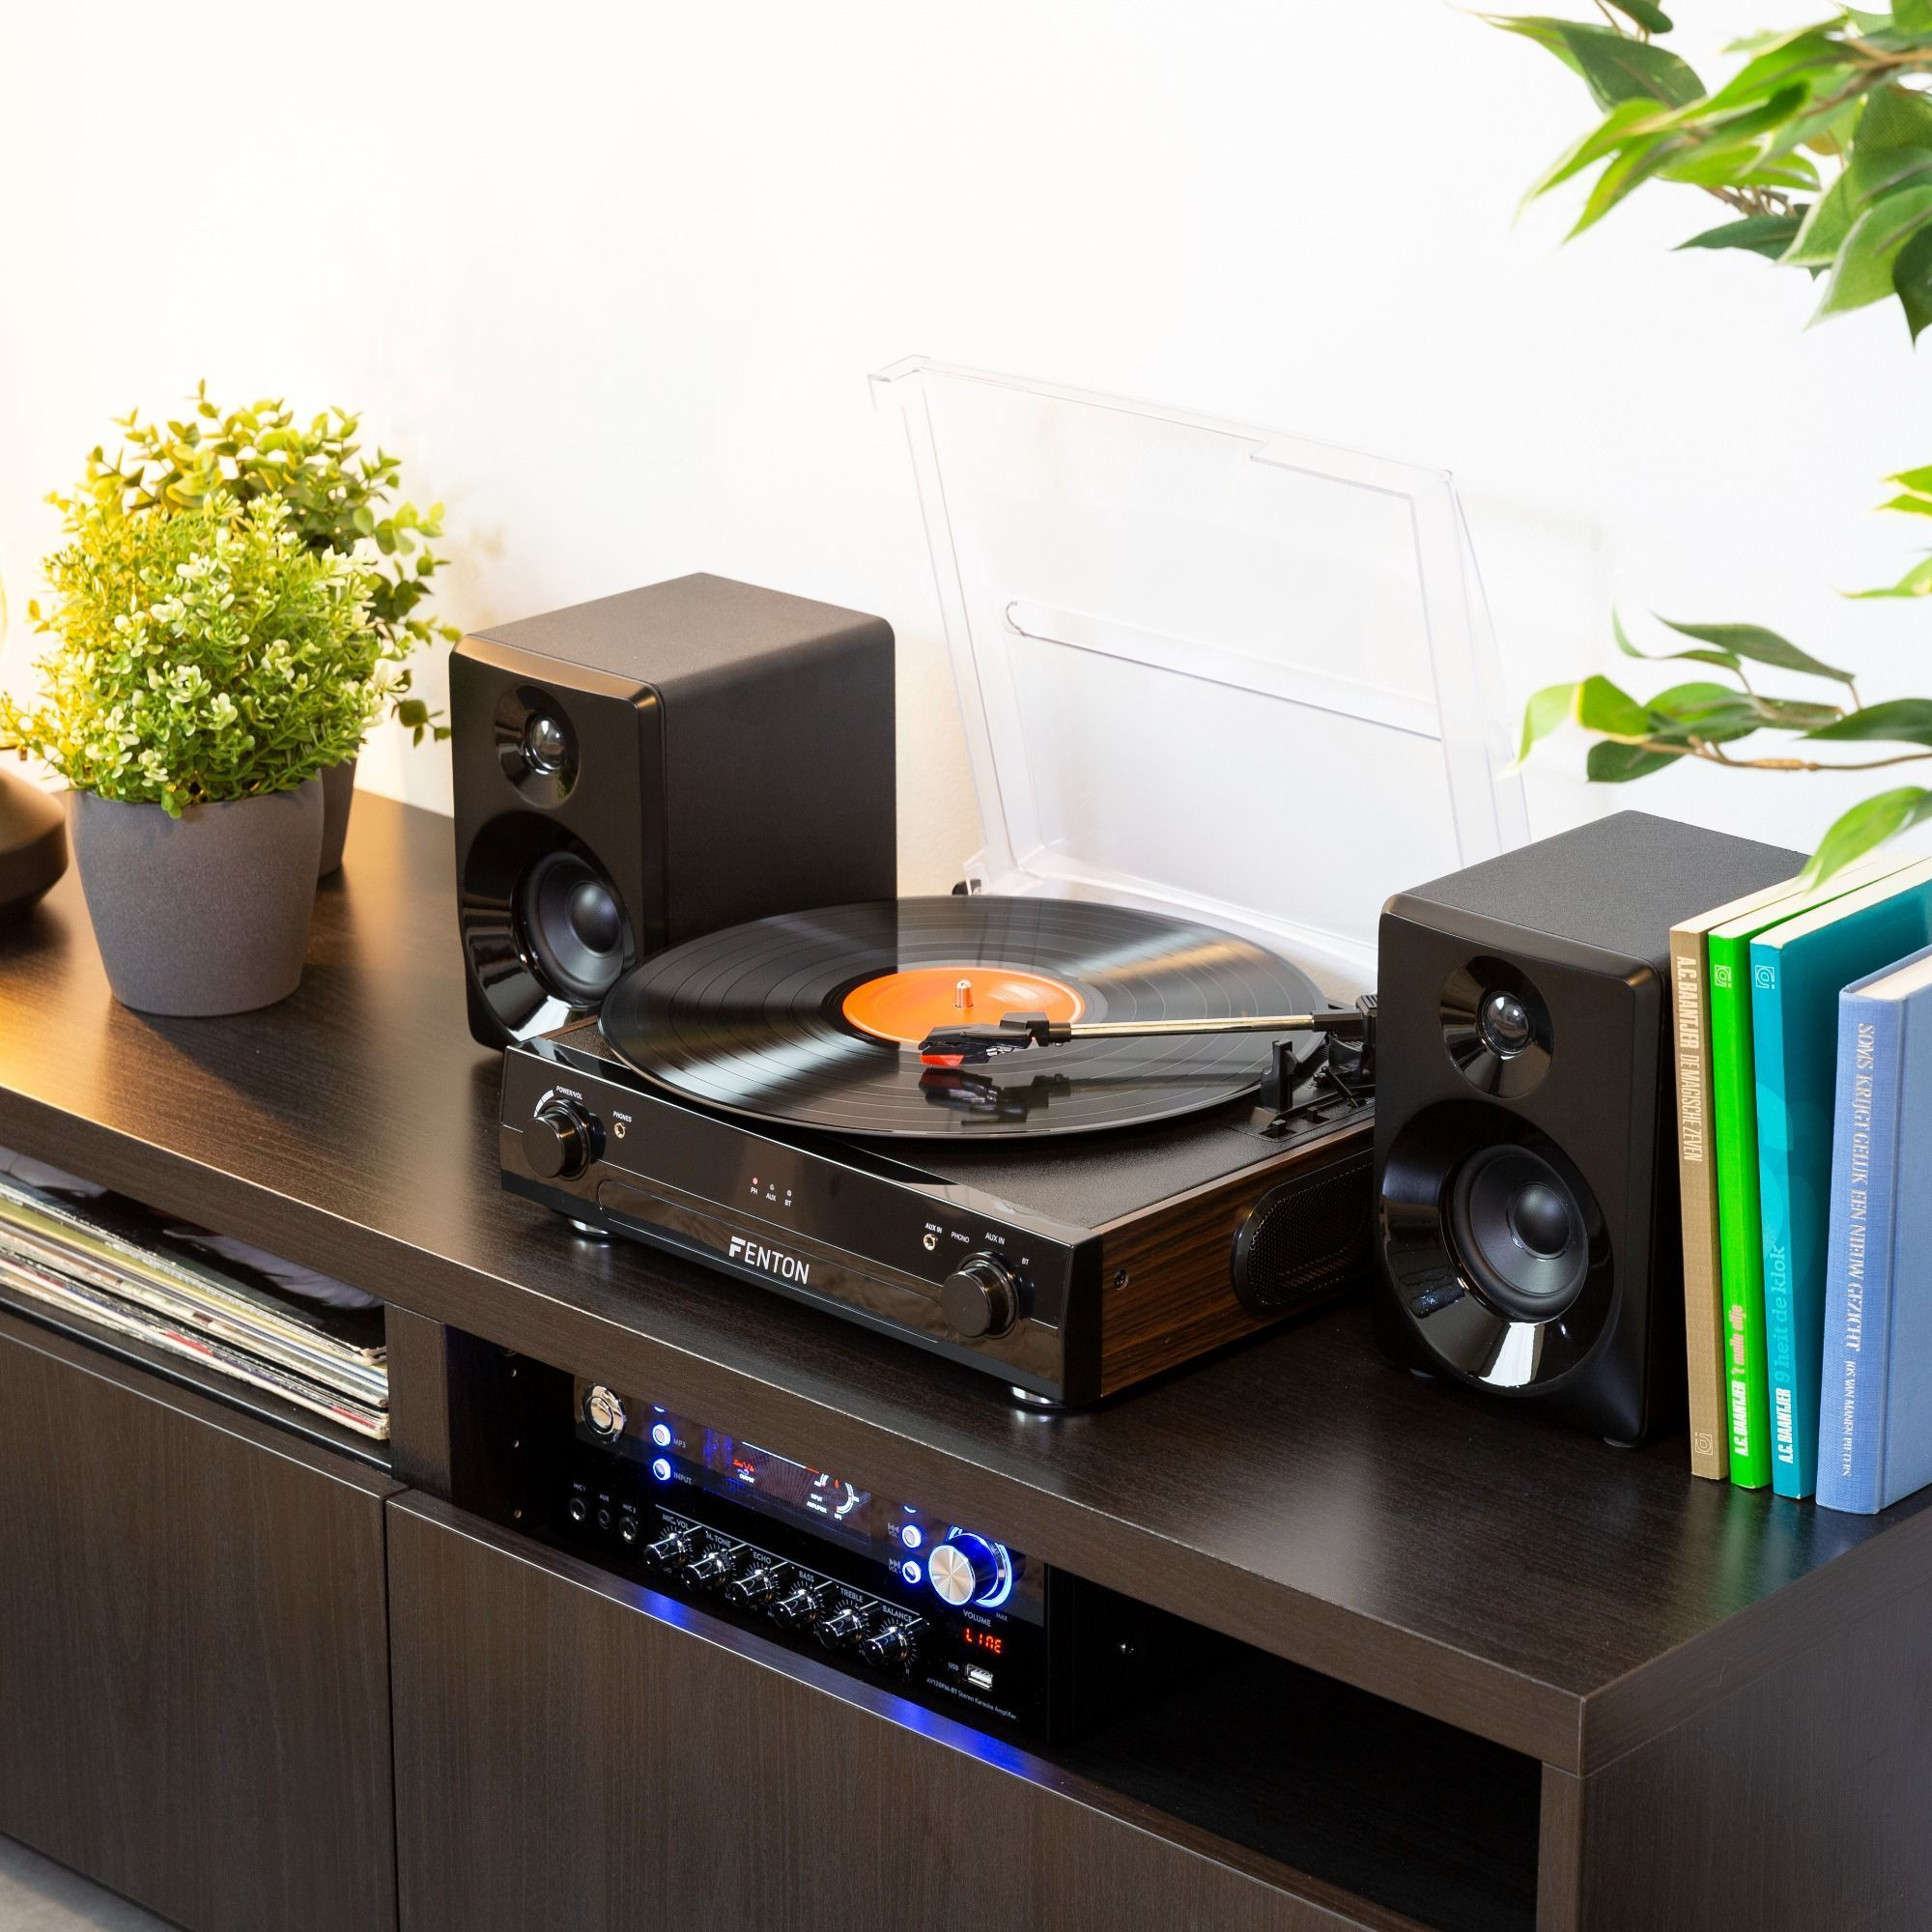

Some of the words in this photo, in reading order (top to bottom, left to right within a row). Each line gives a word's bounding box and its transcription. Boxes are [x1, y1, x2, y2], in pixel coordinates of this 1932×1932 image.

[1677, 981, 1699, 1049] BAANTJER
[1856, 1022, 1875, 1069] SOMS
[1680, 1053, 1699, 1068] DE
[1681, 1068, 1702, 1126] MAGISCHE
[612, 1110, 633, 1122] PHONES
[1682, 1125, 1703, 1162] ZEVEN
[750, 1186, 758, 1195] PH
[765, 1192, 777, 1202] AUX
[1849, 1188, 1867, 1222] EEN
[924, 1222, 936, 1232] AUX
[935, 1226, 943, 1235] IN
[951, 1231, 970, 1243] PHONO
[985, 1232, 998, 1243] AUX
[997, 1236, 1006, 1245] IN
[728, 1236, 810, 1285] FENTON
[1846, 1224, 1866, 1280] NIEUW
[1021, 1257, 1030, 1265] BT
[1770, 1244, 1787, 1293] klok
[1729, 1305, 1747, 1331] elfje
[1771, 1296, 1789, 1323] de
[1845, 1283, 1863, 1351] GEZICHT
[1730, 1333, 1745, 1365] malle
[1772, 1325, 1790, 1369] heit
[1774, 1370, 1790, 1383] 9
[1843, 1378, 1856, 1398] VAN
[1731, 1379, 1747, 1436] BAANTJER
[1776, 1387, 1793, 1443] BAANTJER
[673, 1437, 687, 1448] MP3
[673, 1471, 693, 1485] INPUT
[599, 1493, 610, 1502] AUX
[622, 1502, 633, 1513] MIC
[676, 1519, 689, 1530] VOL
[714, 1534, 731, 1548] TONE
[753, 1550, 772, 1565] ECHO
[798, 1570, 815, 1583] BASS
[839, 1587, 864, 1604] TREBLE
[882, 1605, 913, 1623] BALANCE
[962, 1608, 992, 1628] VOLUME
[995, 1611, 1008, 1622] MAX
[966, 1628, 1003, 1654] LINE
[948, 1662, 959, 1671] USB
[957, 1690, 975, 1702] Stereo
[975, 1697, 994, 1711] Karaoke
[994, 1705, 1017, 1720] Amplifier
